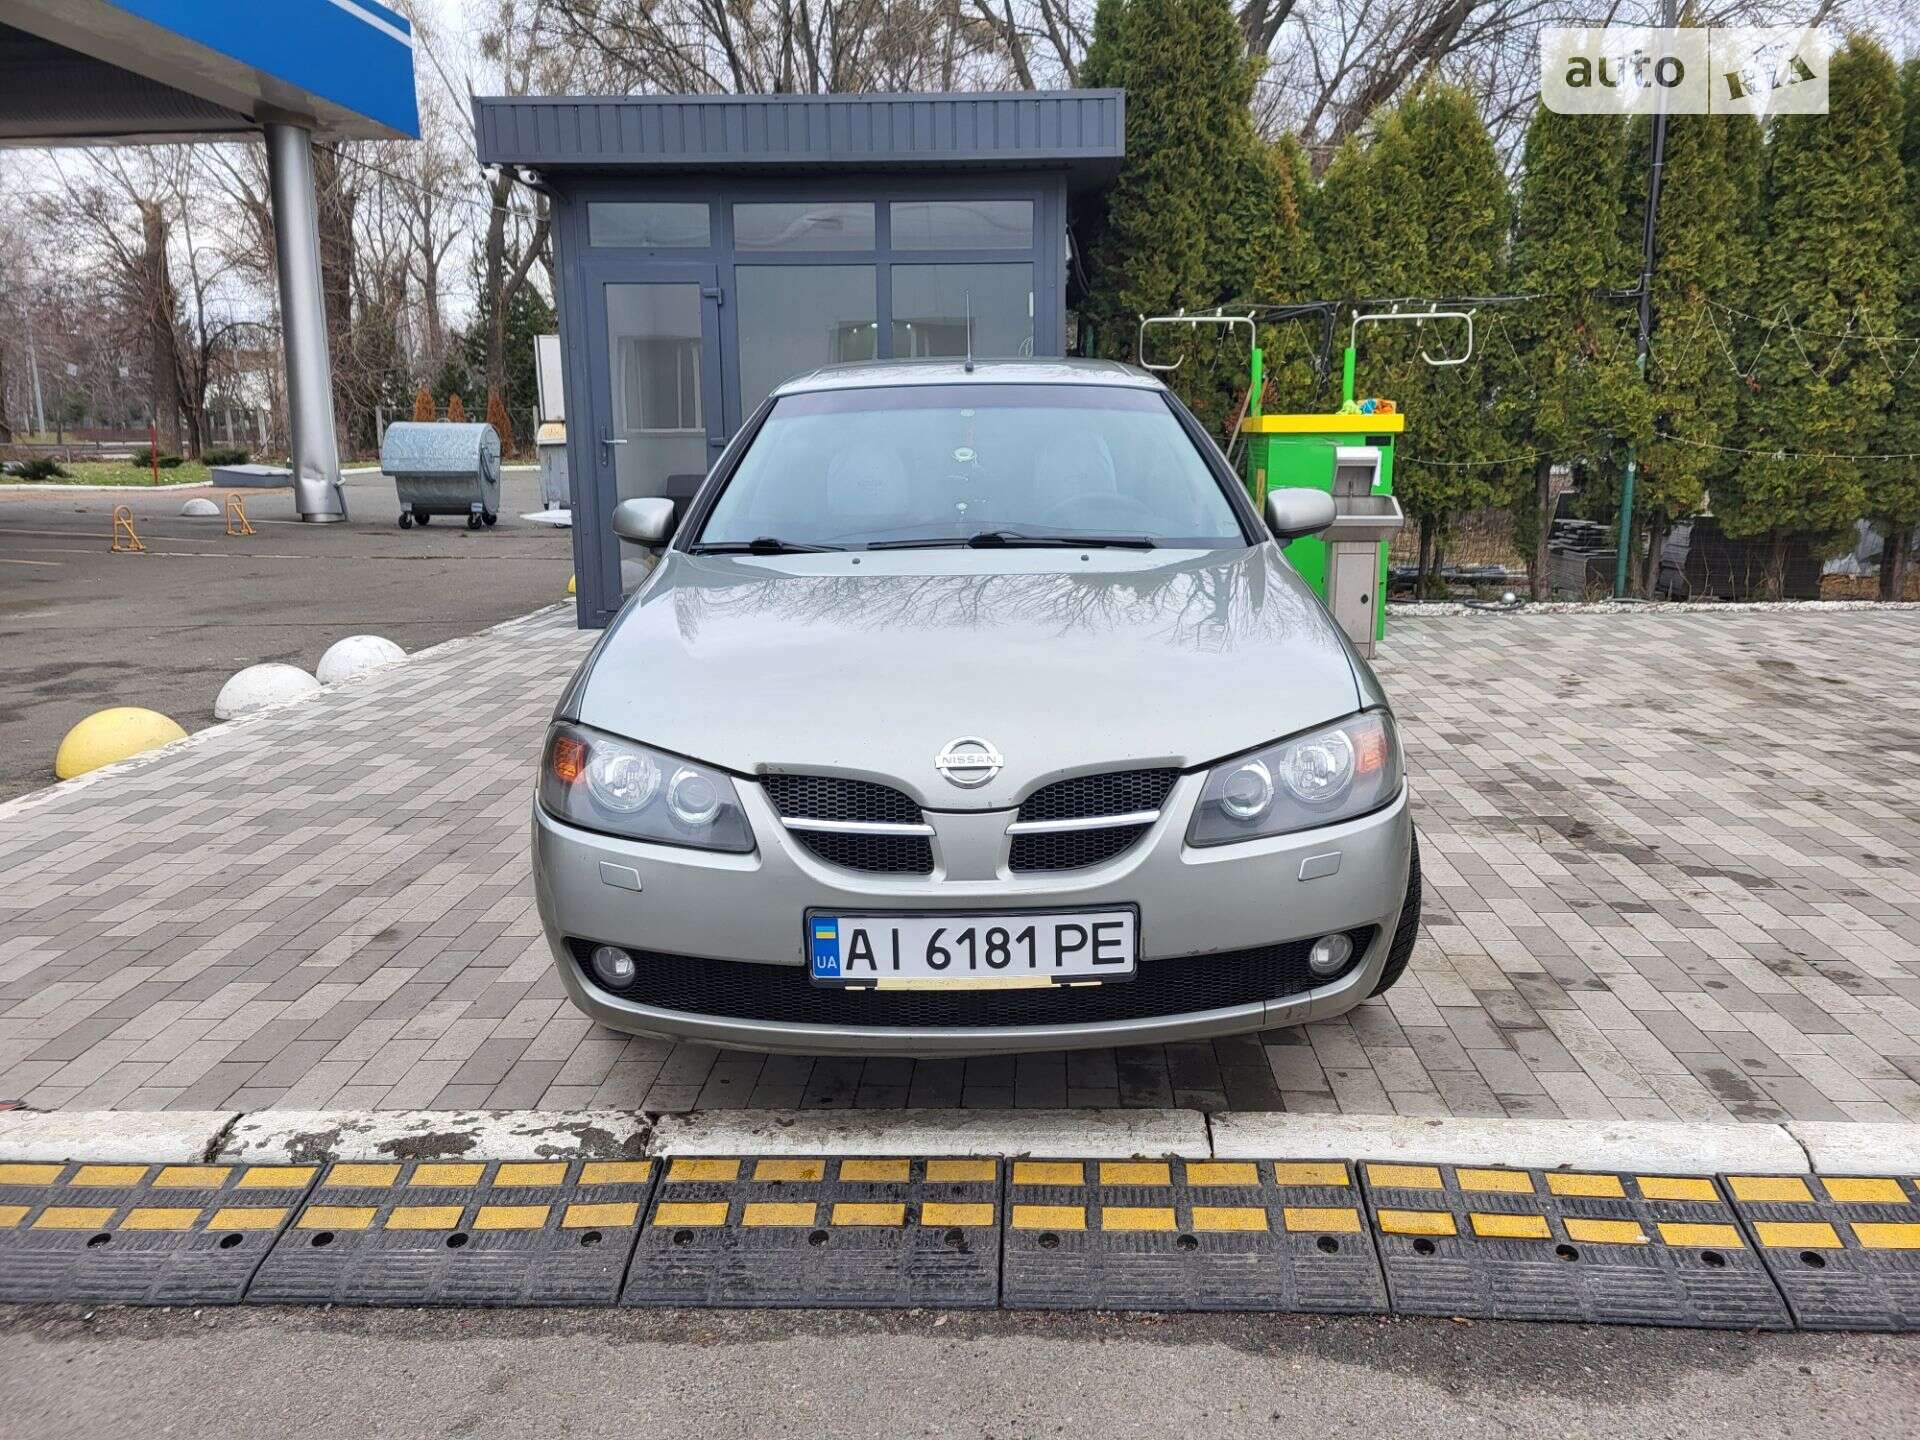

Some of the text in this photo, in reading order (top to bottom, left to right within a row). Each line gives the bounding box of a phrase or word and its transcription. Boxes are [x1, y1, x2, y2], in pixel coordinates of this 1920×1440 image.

[942, 755, 997, 765] NISSAN
[925, 925, 1037, 971] 6181
[1054, 920, 1126, 968] PE
[816, 955, 838, 969] UA
